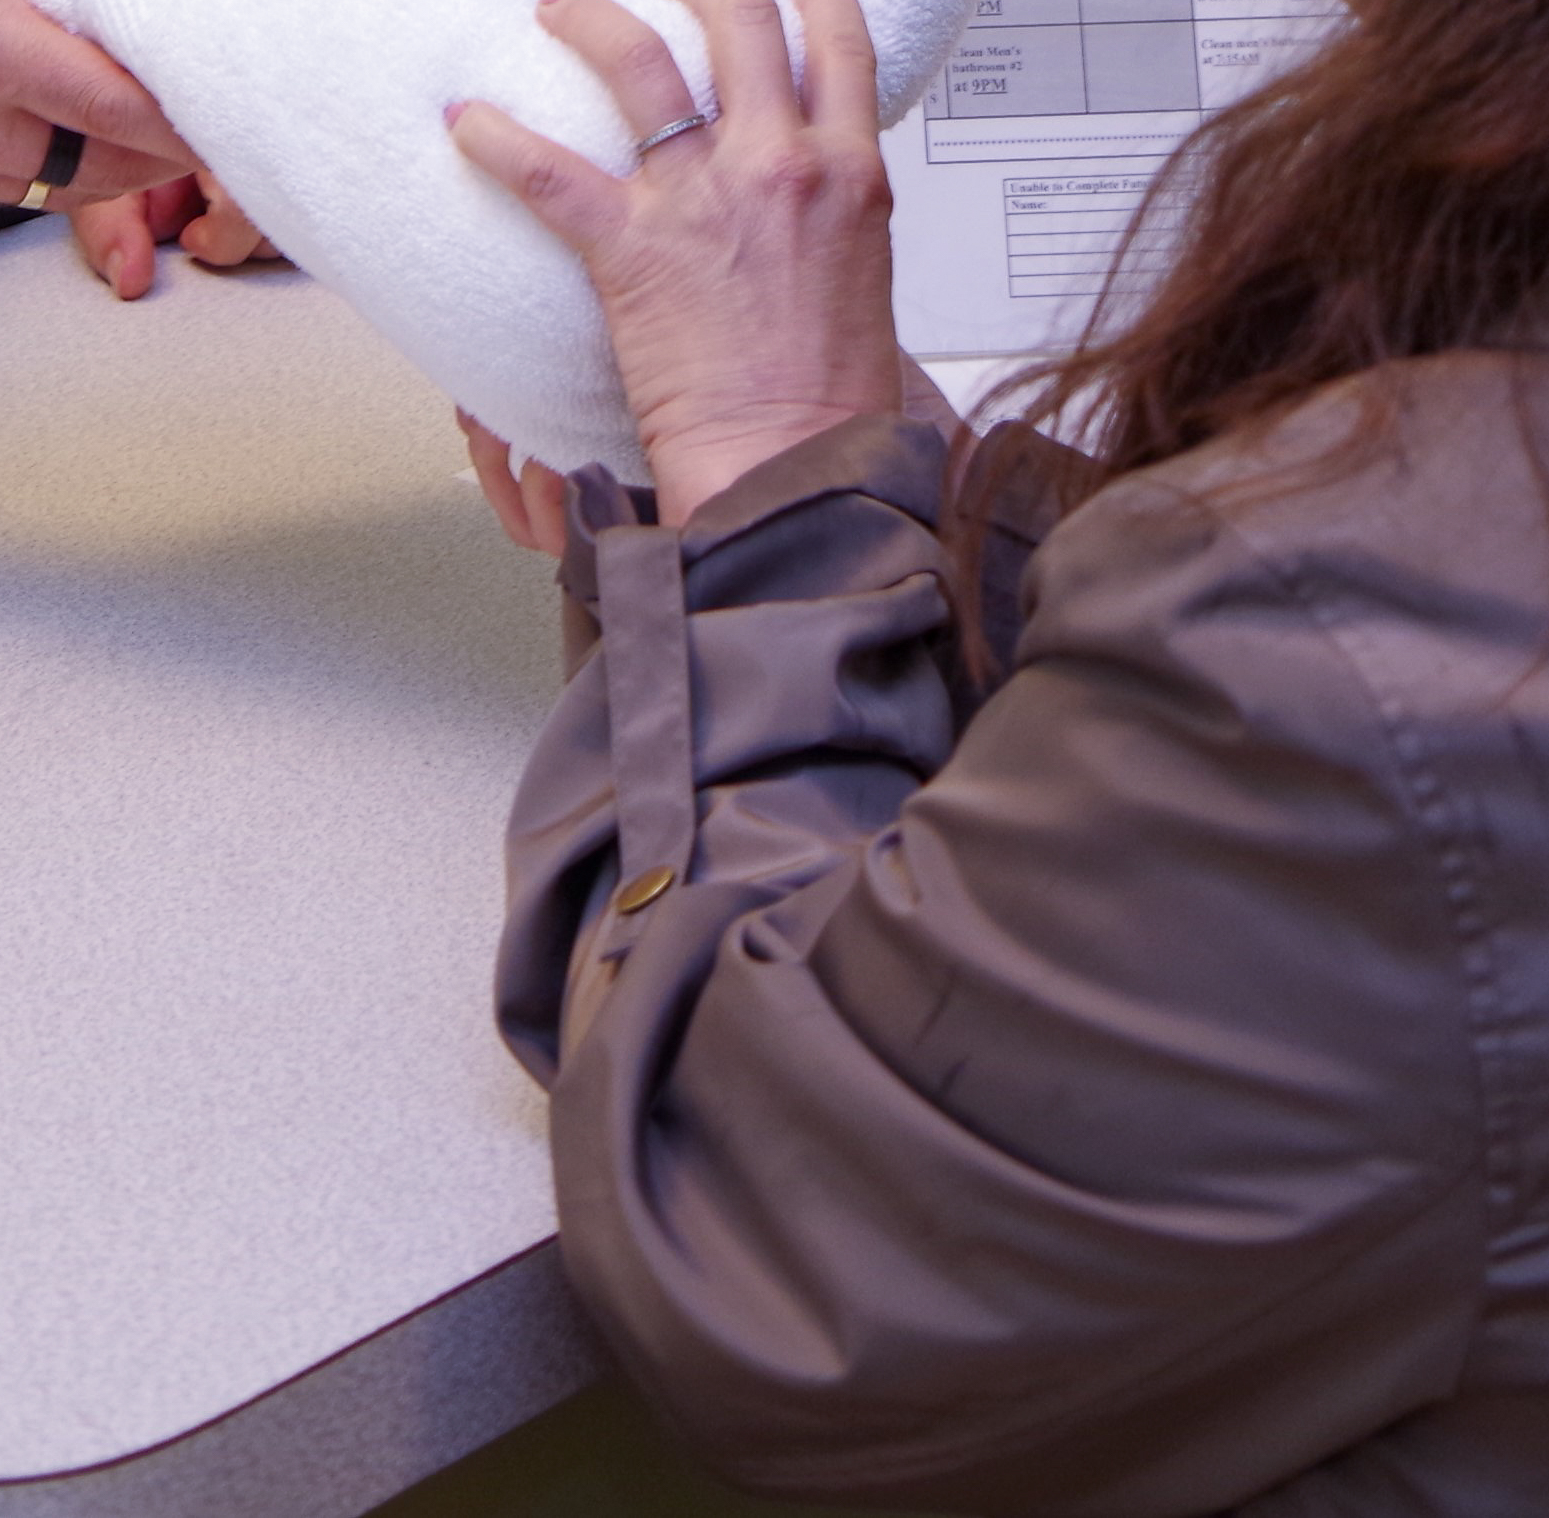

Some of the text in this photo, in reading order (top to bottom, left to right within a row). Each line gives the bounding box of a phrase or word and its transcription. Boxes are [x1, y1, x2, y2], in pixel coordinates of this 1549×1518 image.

[976, 0, 1003, 16] PM
[1201, 38, 1233, 49] Clean
[986, 46, 1021, 56] Men's
[952, 61, 1023, 73] bathroom #2
[953, 82, 968, 93] at
[972, 77, 1008, 95] 9PM
[1010, 181, 1050, 193] Unable
[1052, 181, 1064, 192] to
[1066, 179, 1118, 194] Complete
[1011, 200, 1047, 210] Name:
